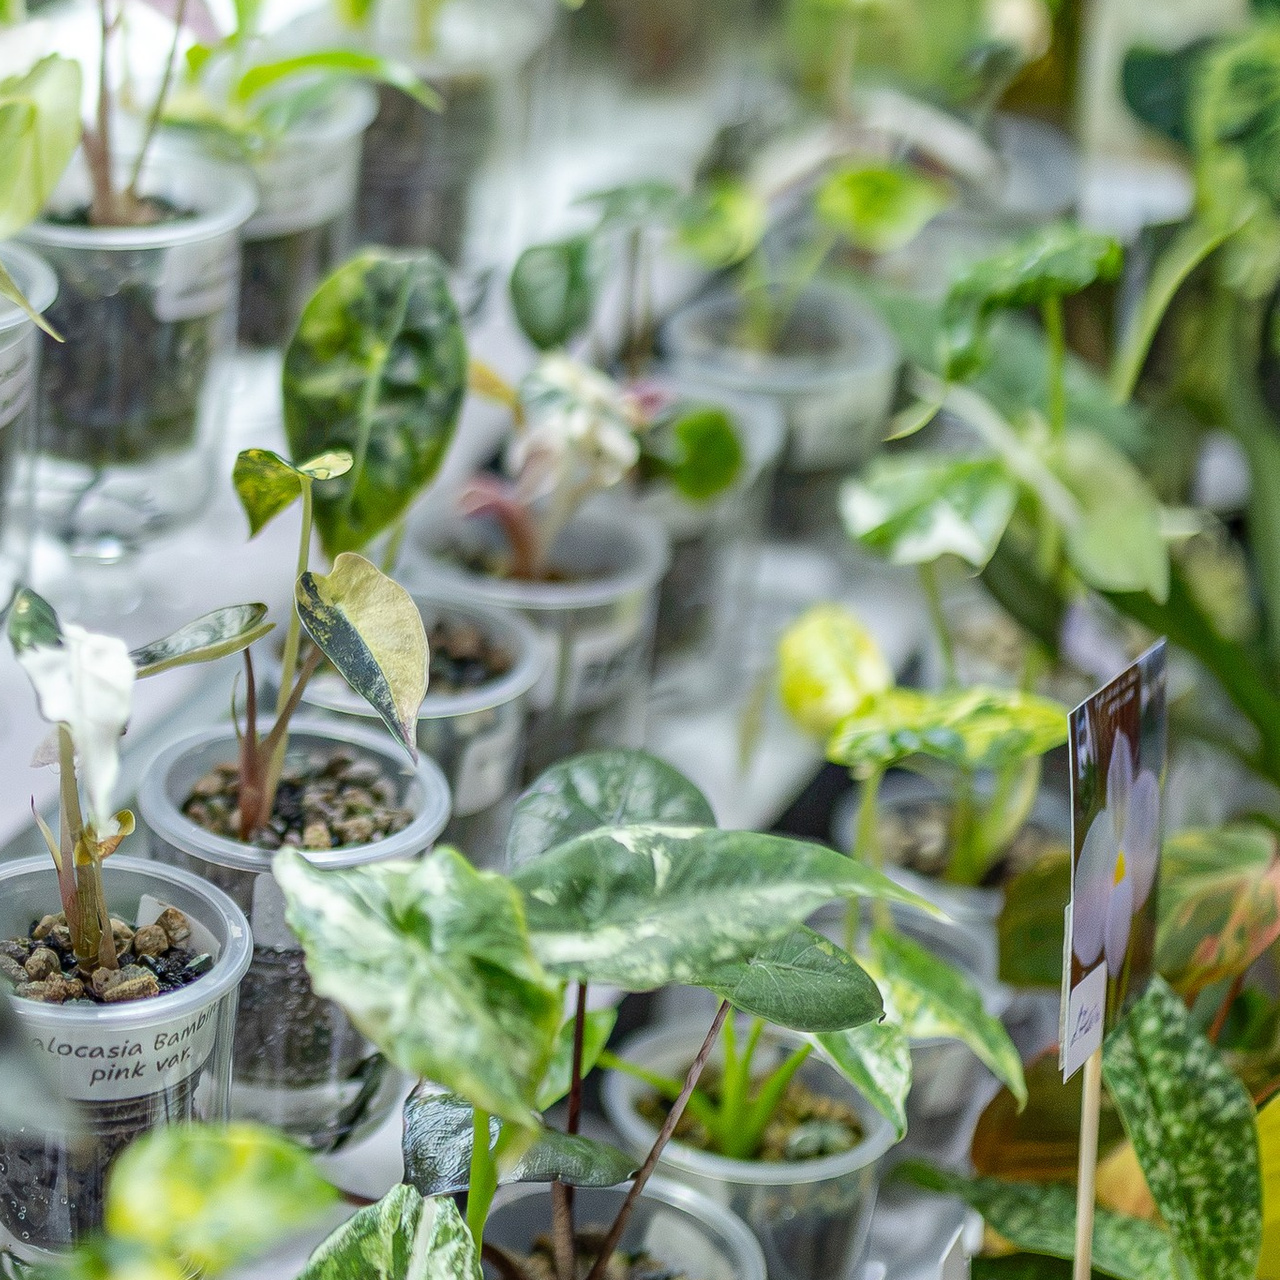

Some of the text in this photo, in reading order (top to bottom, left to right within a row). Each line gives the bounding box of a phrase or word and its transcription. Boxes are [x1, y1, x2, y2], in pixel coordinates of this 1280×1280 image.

[32, 1036, 143, 1059] alocasia
[89, 1045, 191, 1087] pink var.
